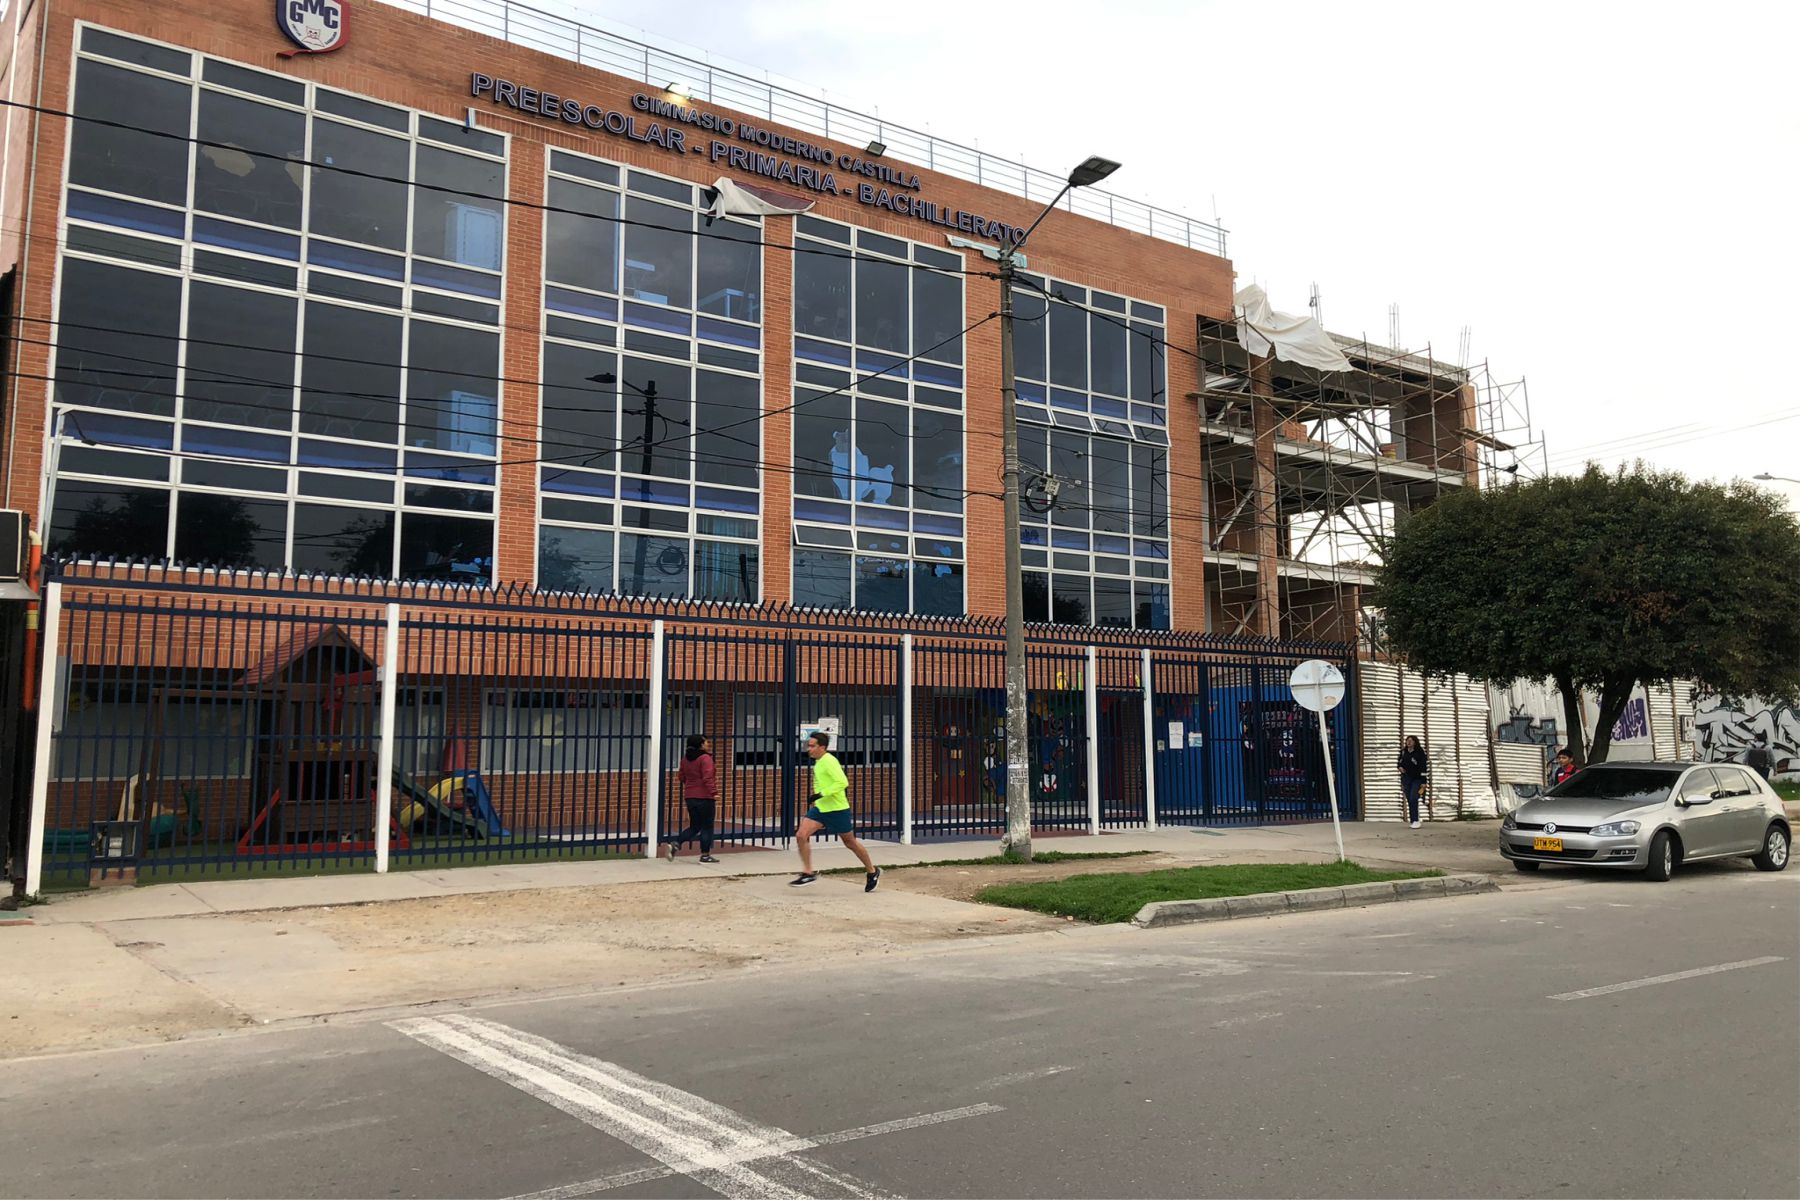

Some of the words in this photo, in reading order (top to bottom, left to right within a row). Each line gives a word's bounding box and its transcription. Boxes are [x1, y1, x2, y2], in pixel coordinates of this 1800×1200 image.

[290, 0, 339, 29] GMC
[471, 72, 687, 154] PREESCOLAR
[711, 139, 839, 195] PRIMARIA
[859, 182, 1028, 246] BACHILLERATO
[632, 92, 735, 136] GIMNASIO
[739, 123, 836, 165] MODERNO
[839, 153, 922, 192] CASTILLA
